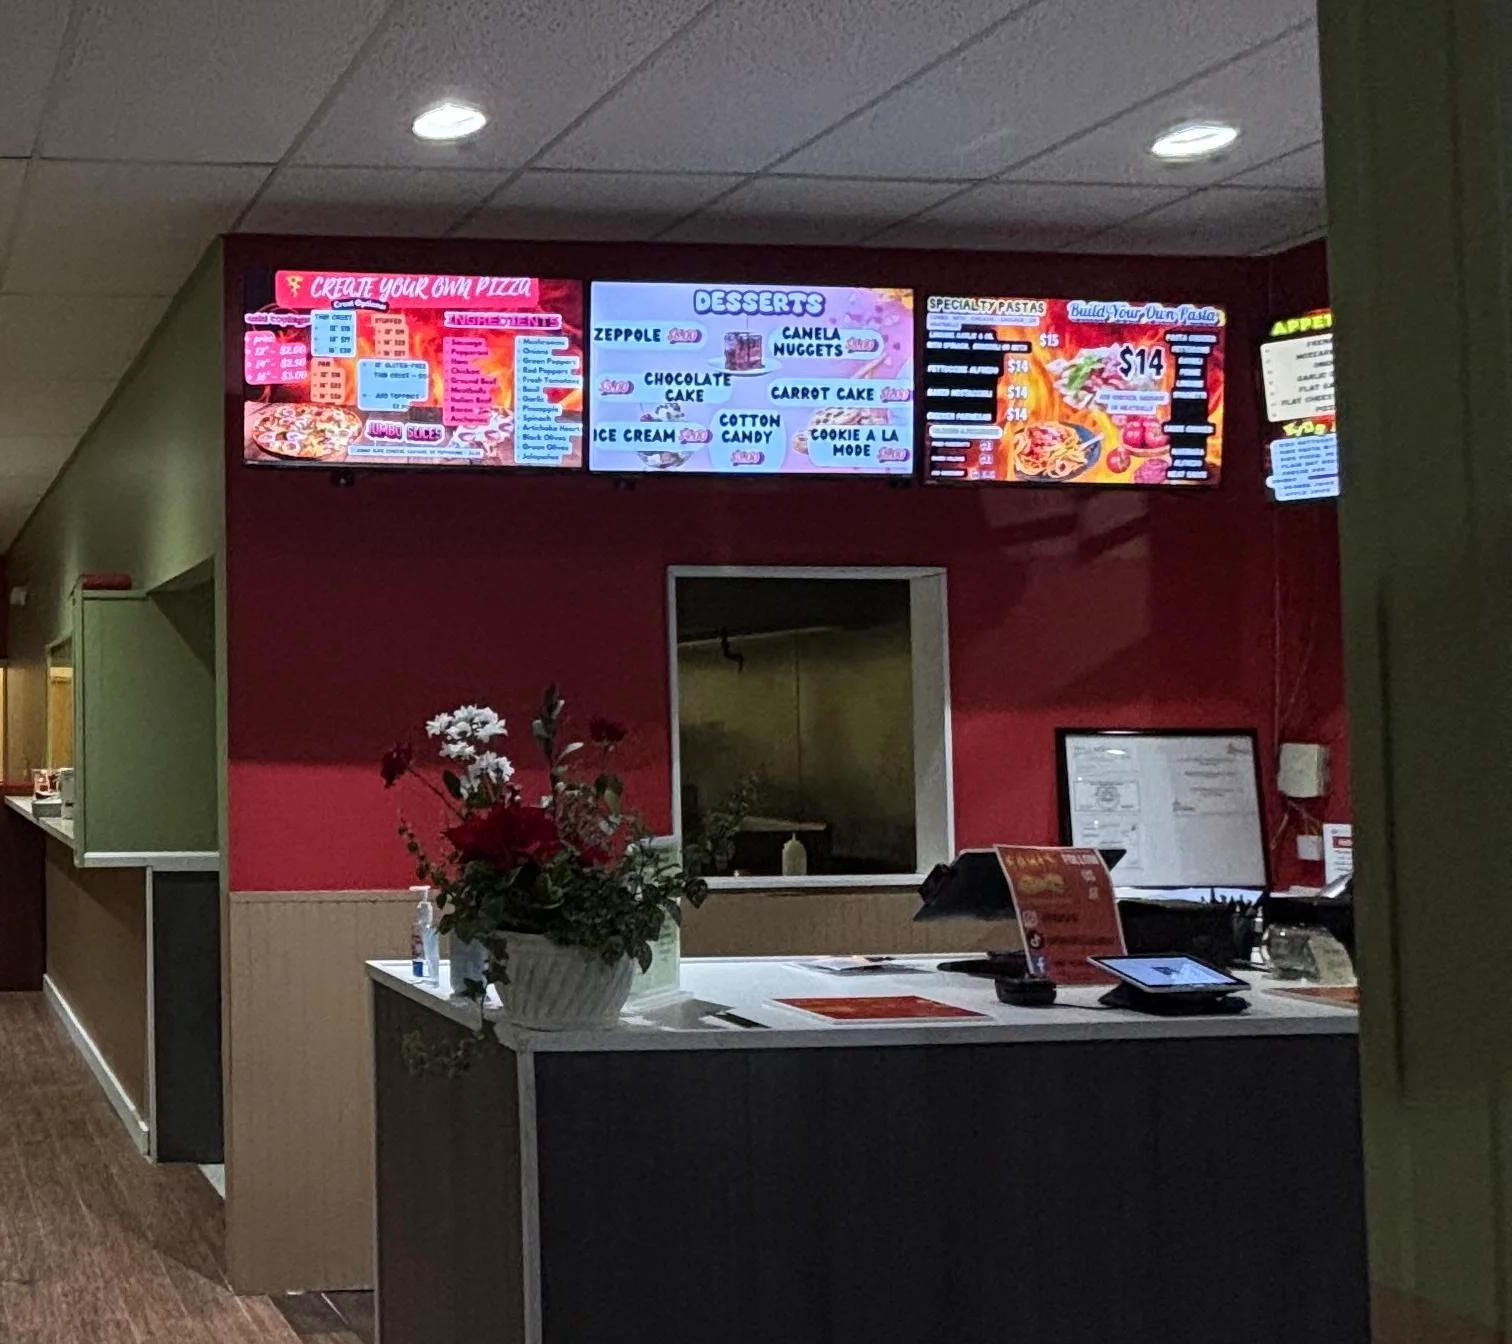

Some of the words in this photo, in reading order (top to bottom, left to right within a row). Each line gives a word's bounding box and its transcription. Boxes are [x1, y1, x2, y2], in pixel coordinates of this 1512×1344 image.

[310, 275, 376, 298] CREATE
[379, 276, 431, 301] YOUR
[431, 277, 471, 298] OWN
[475, 277, 531, 297] PIZZA
[694, 289, 825, 315] DESSERTS
[929, 298, 995, 312] SPECIALTY
[998, 302, 1045, 313] PASTAS
[1070, 303, 1106, 318] Build
[1111, 304, 1141, 319] Your
[1179, 306, 1216, 322] Pasta
[446, 314, 559, 327] INGREDIENTS
[594, 328, 661, 342] ZEPPOLE
[782, 326, 841, 340] CANELA
[1039, 332, 1060, 348] $15
[773, 343, 843, 357] NUGGETS
[1120, 346, 1163, 377] $14
[644, 372, 731, 386] CHOCOLATE
[664, 389, 704, 402] CAKE
[770, 386, 830, 401] CARROT
[836, 387, 875, 401] CAKE
[1007, 384, 1028, 399] $14
[719, 413, 781, 427] COTTON
[1007, 407, 1028, 422] $14
[368, 422, 402, 439] JUMBO
[593, 428, 617, 442] ICE
[623, 429, 675, 442] CREAM
[721, 430, 773, 444] CANDY
[810, 428, 860, 441] COOKIE
[865, 429, 876, 441] A
[881, 429, 899, 442] LA
[832, 444, 871, 457] MODE
